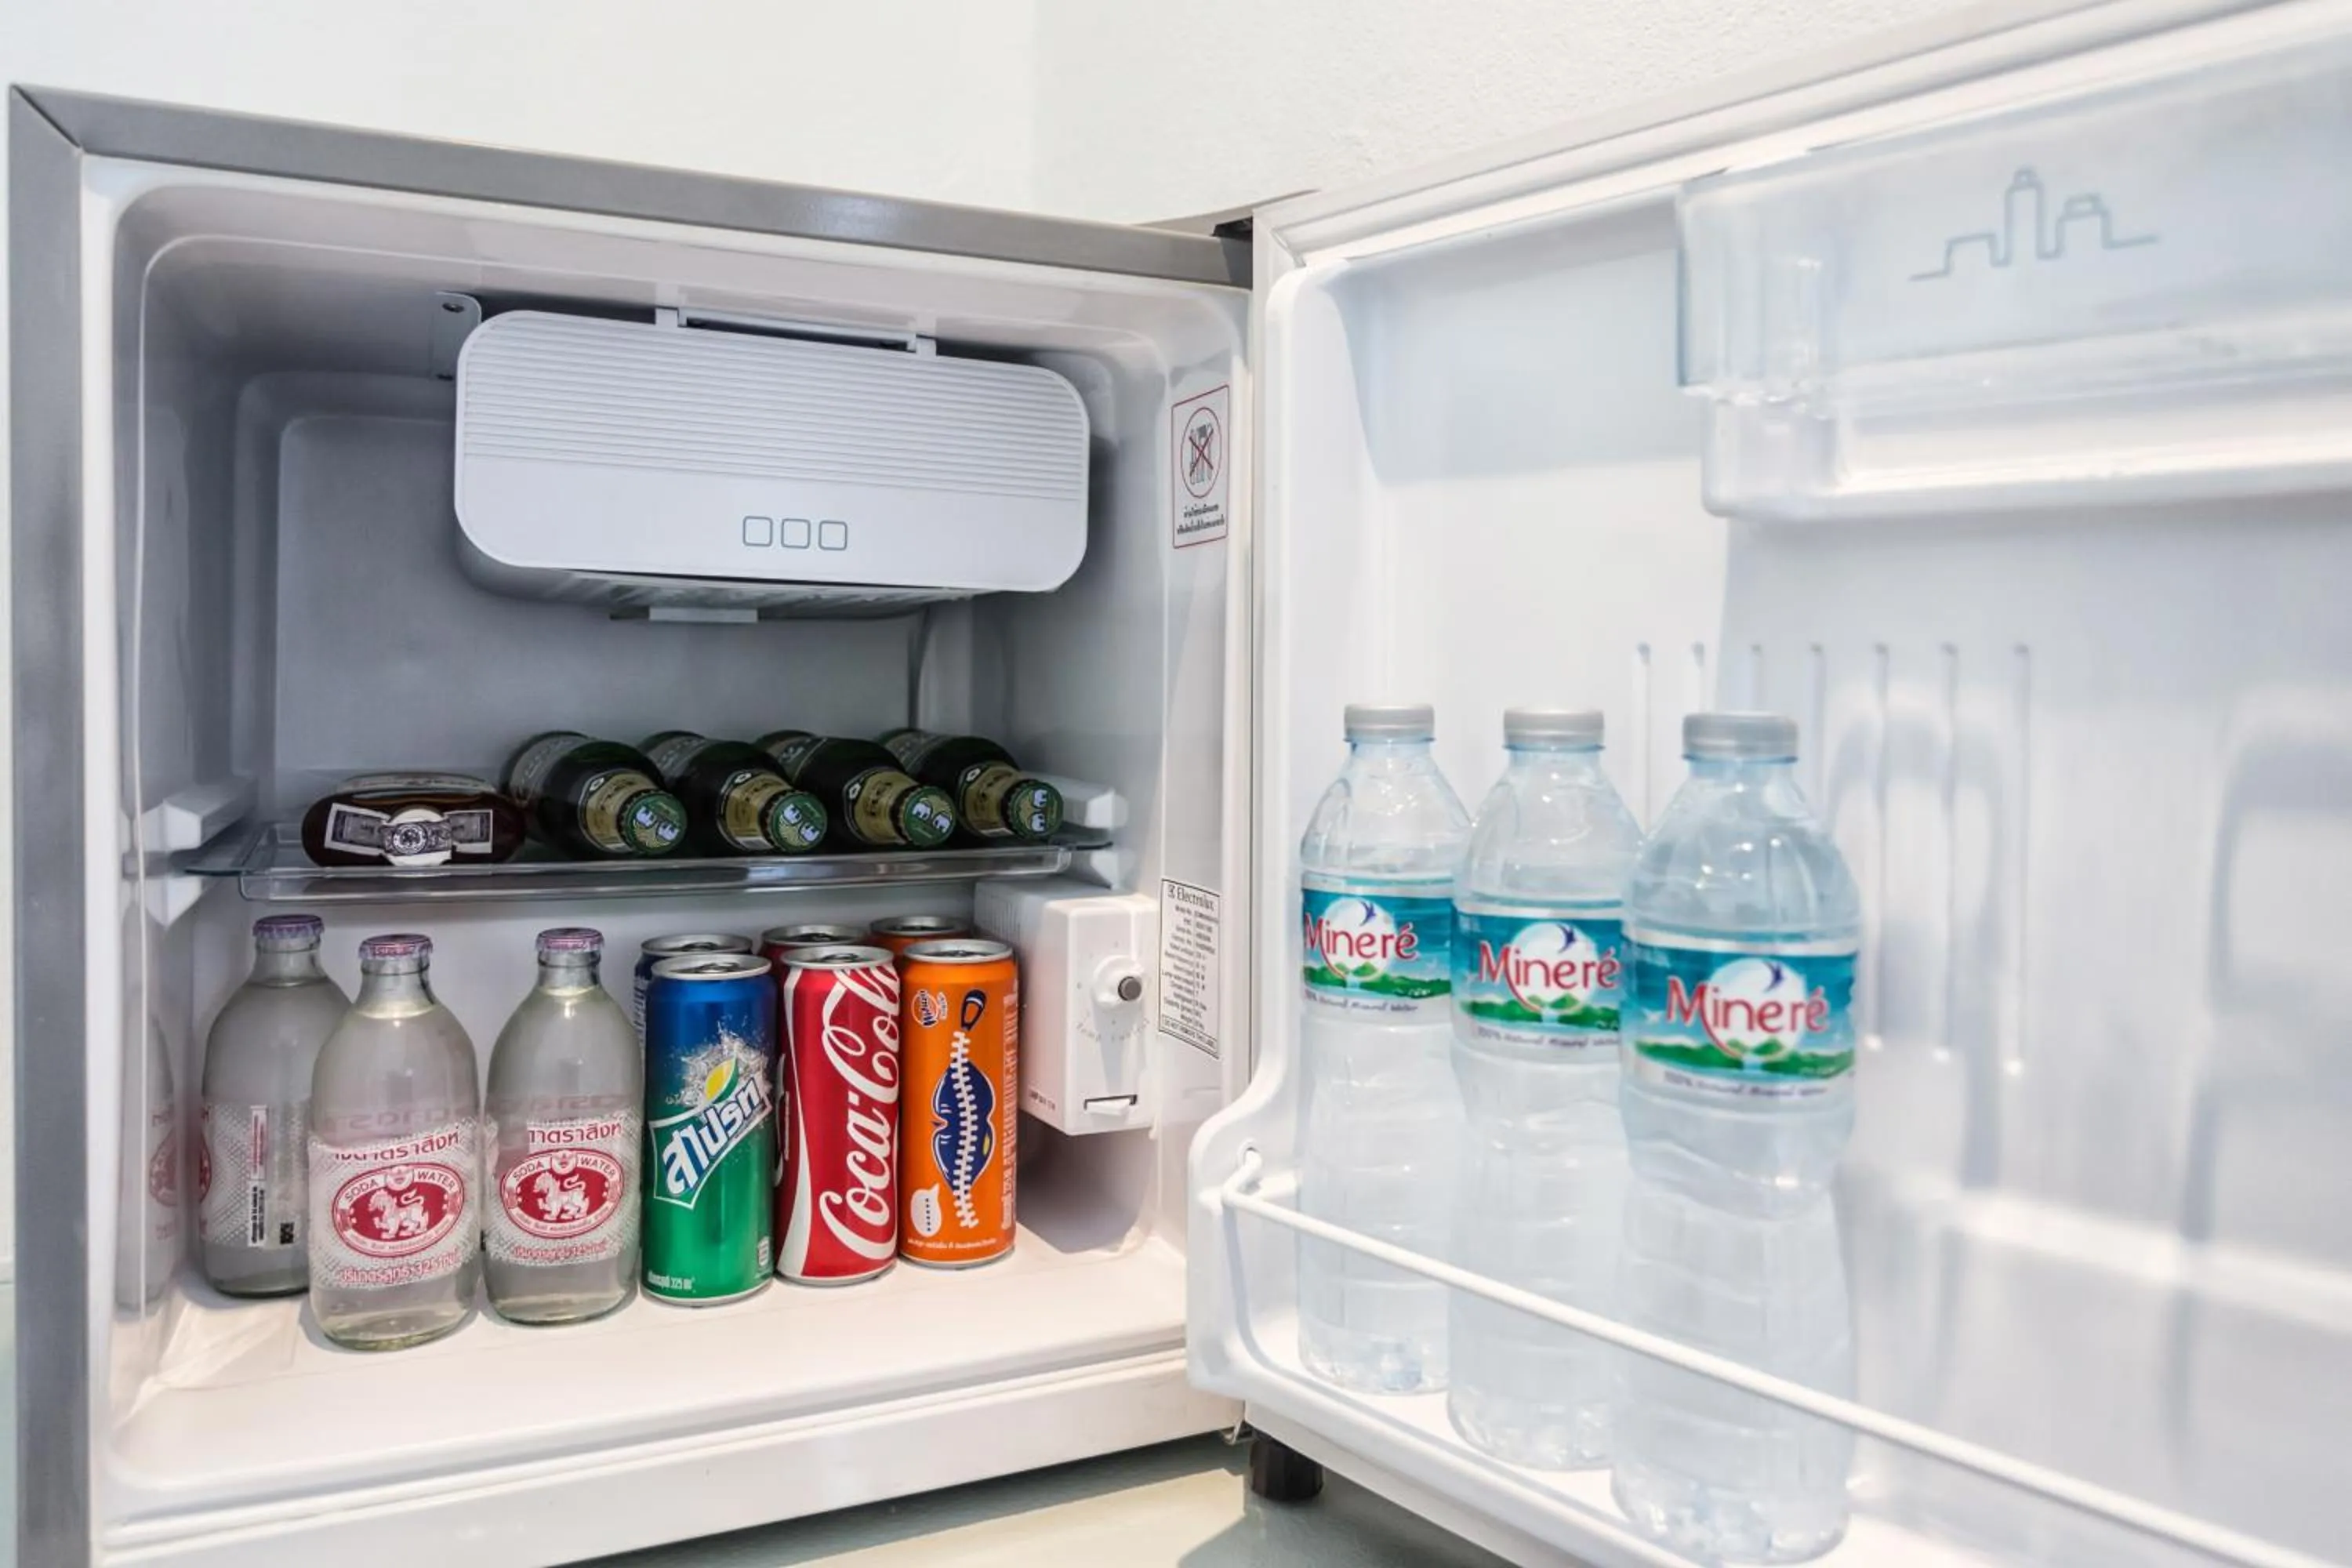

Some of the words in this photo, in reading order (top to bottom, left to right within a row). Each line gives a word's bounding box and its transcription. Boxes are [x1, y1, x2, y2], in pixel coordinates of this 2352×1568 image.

[1304, 913, 1418, 979] Mineré
[1479, 940, 1620, 1012] Mineré
[1666, 976, 1829, 1058] Mineré
[345, 1178, 380, 1202] SODA
[417, 1171, 458, 1191] WATER
[513, 1159, 545, 1181] SODA
[579, 1156, 616, 1179] WATER
